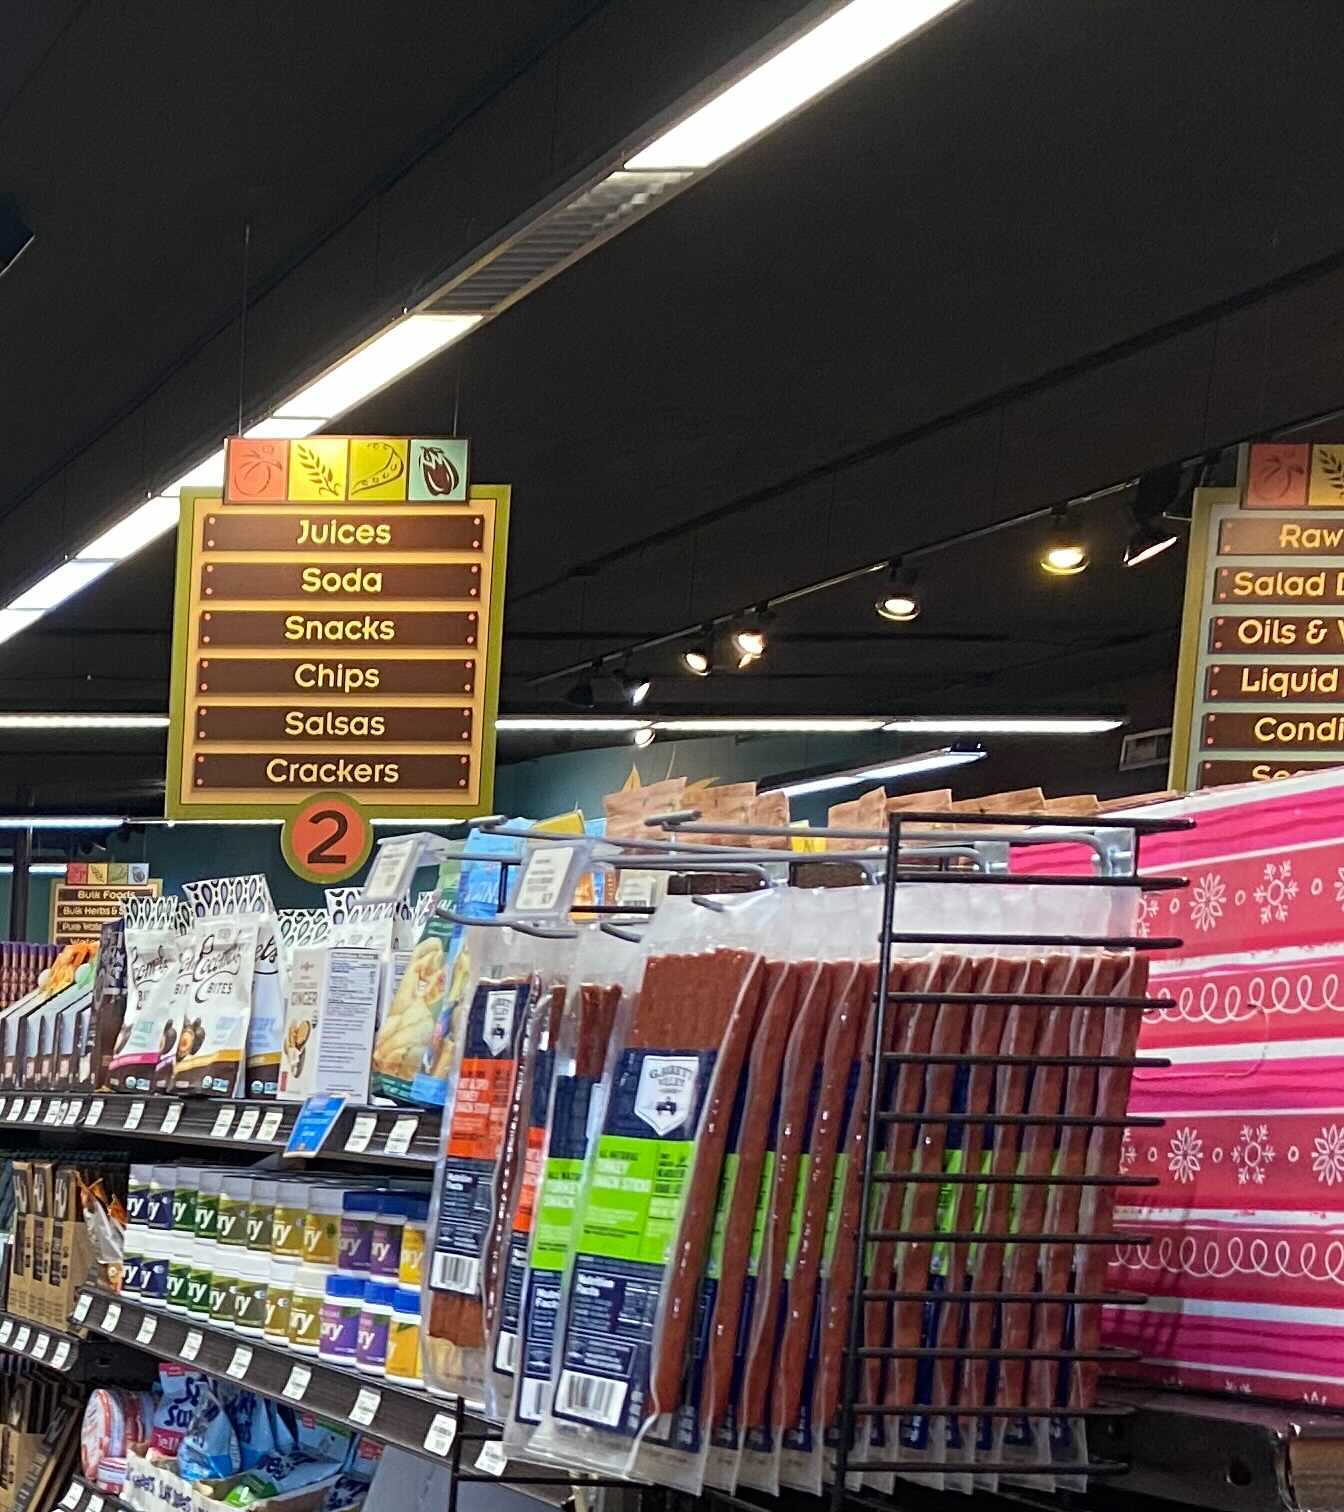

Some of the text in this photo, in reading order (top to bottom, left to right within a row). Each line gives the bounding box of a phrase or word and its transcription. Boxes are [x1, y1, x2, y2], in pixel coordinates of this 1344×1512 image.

[296, 519, 392, 545] Juices
[1279, 524, 1343, 548] Raw
[301, 568, 382, 592] Soda
[1234, 571, 1324, 596] Salad
[284, 616, 395, 641] Snacks
[1238, 619, 1327, 645] Oils &
[294, 663, 380, 692] Chips
[1241, 667, 1338, 698] Liquid
[284, 711, 385, 736] Salsas
[266, 758, 399, 783] Crackers
[307, 810, 348, 864] 2
[78, 889, 137, 900] Bulk Foods
[62, 906, 81, 916] Bulk
[82, 905, 108, 916] Herbs
